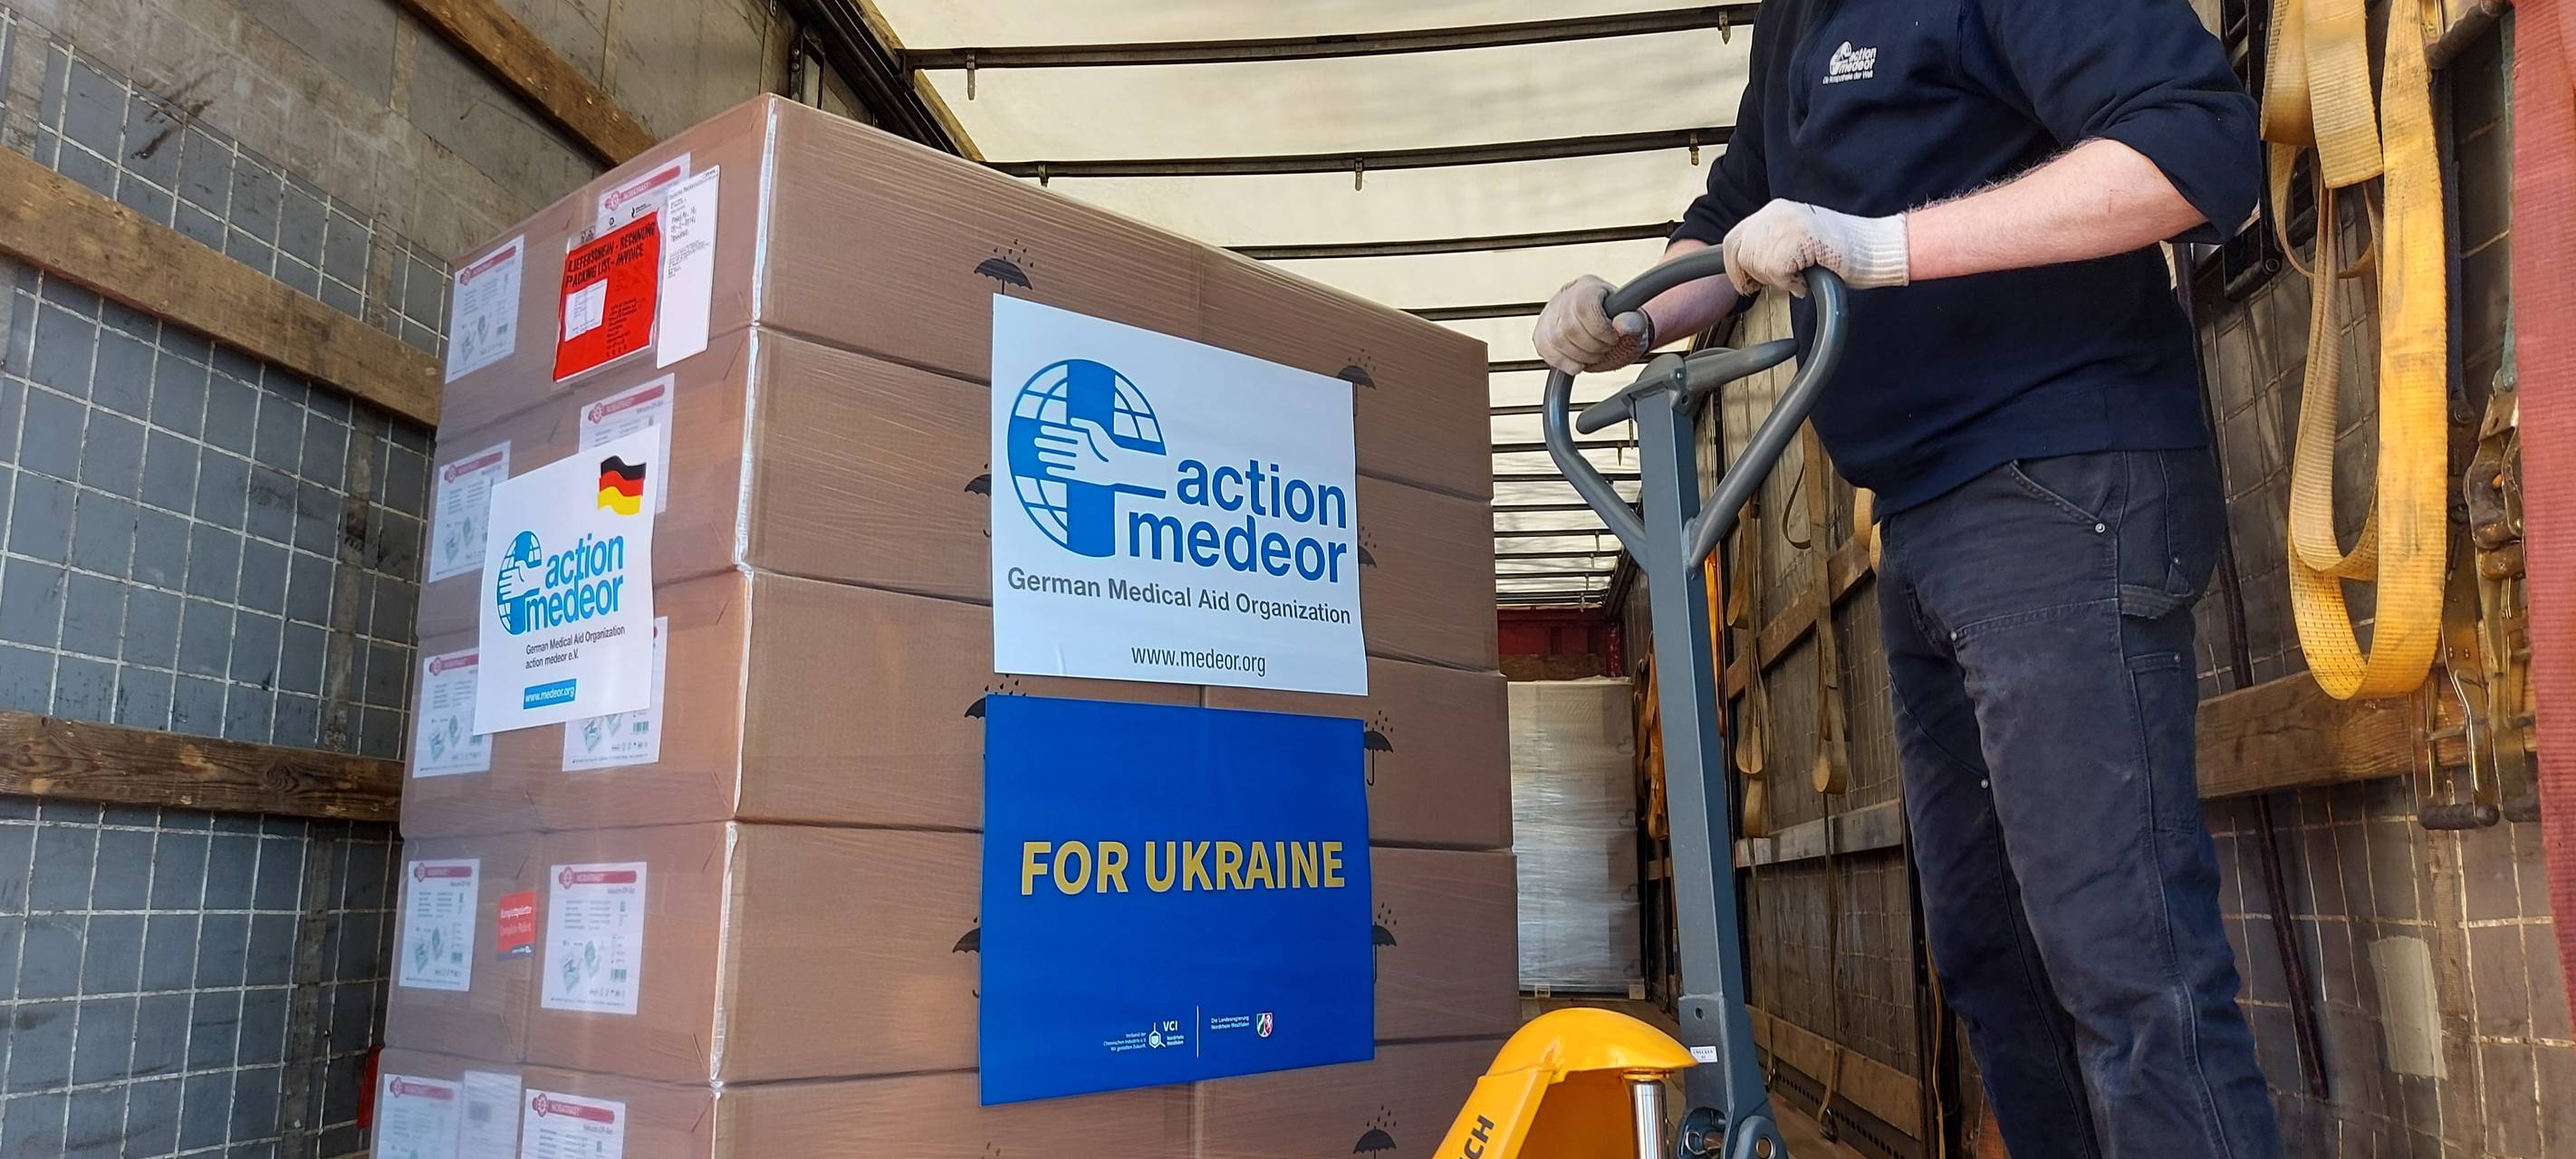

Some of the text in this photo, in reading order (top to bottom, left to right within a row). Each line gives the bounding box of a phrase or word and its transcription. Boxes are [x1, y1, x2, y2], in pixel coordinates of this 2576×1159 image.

[1838, 58, 1876, 74] medeor
[1849, 47, 1878, 62] action
[597, 257, 610, 274] LIST
[616, 243, 644, 266] INVOICE
[1177, 457, 1347, 529] action
[545, 532, 624, 589] action
[1129, 510, 1348, 584] medeor
[526, 575, 624, 632] medeor
[1006, 566, 1351, 625] German Medical Aid Organization
[525, 625, 625, 655] German Medical Aid Organization
[525, 648, 579, 669] action medeor e.V.
[1131, 646, 1266, 677] www.medeor.org
[525, 685, 575, 703] www.medeor.org
[1020, 840, 1345, 896] FOR UKRAINE
[1162, 1020, 1178, 1032] VCI
[1458, 1115, 1495, 1159] CH
